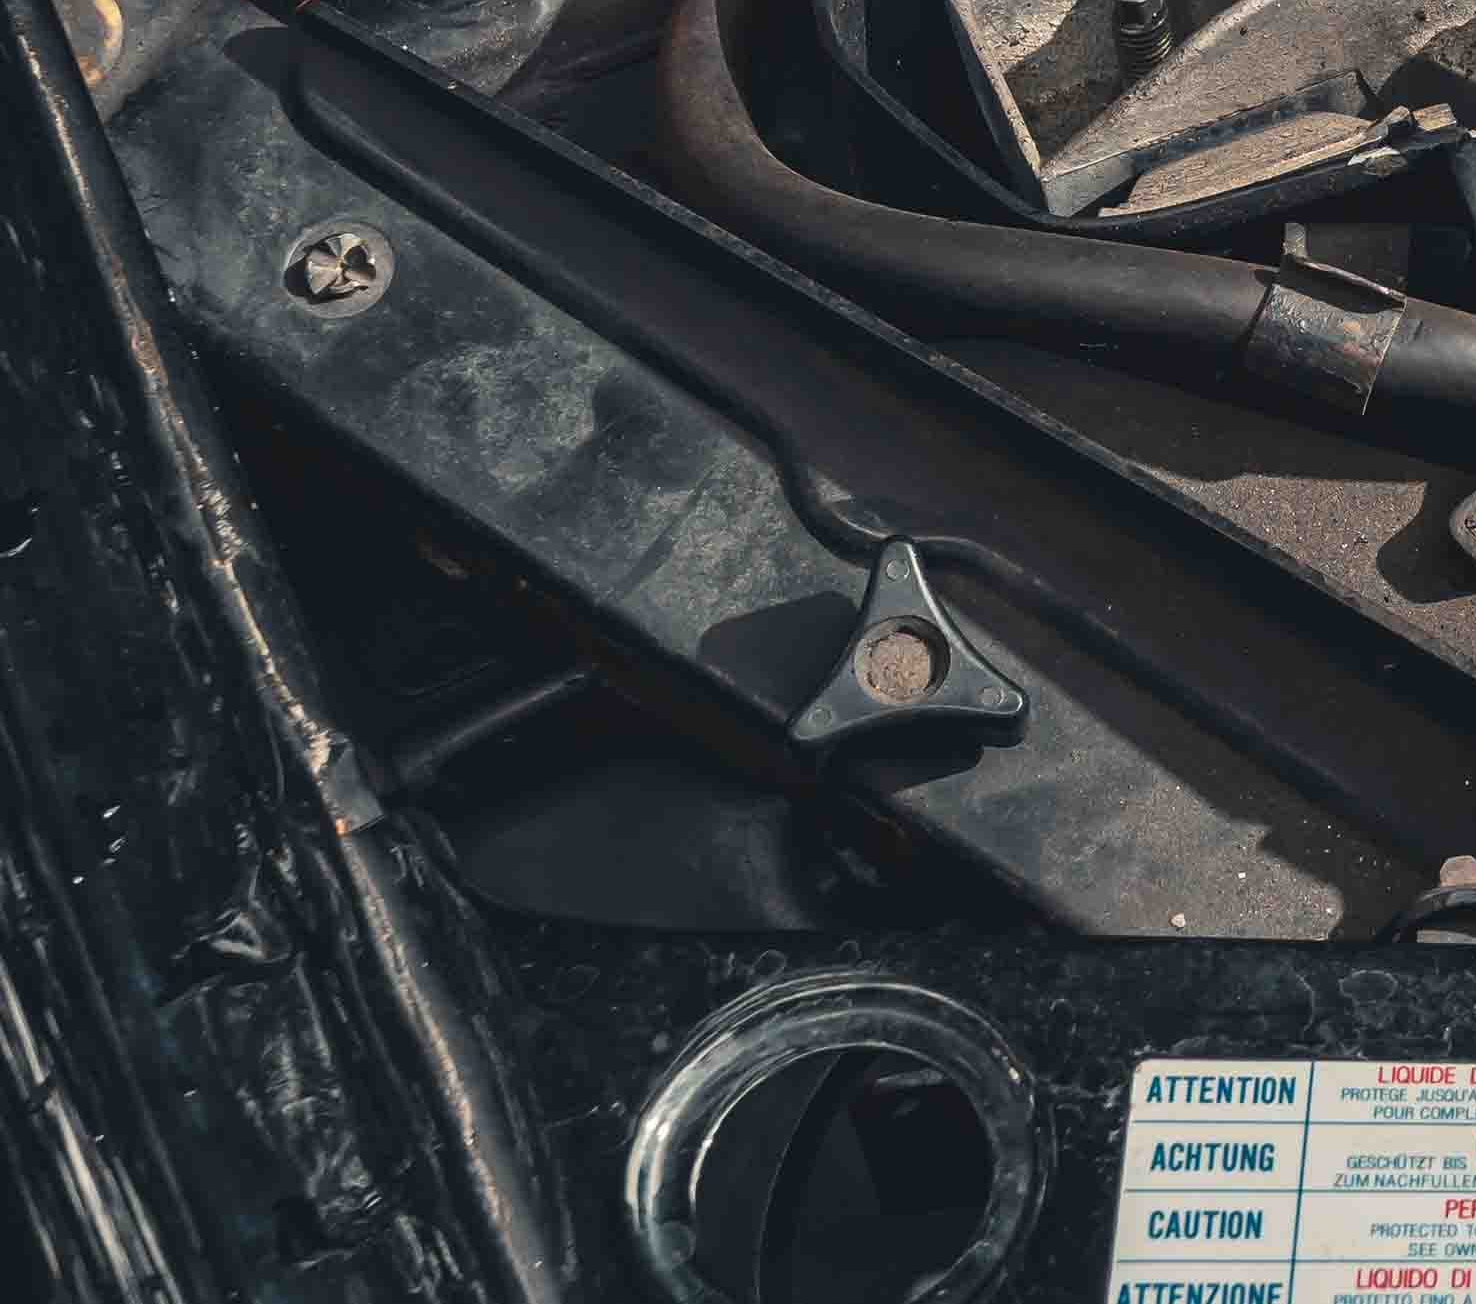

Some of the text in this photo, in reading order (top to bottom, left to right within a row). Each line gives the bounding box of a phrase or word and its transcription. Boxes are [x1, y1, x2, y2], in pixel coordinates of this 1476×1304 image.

[1378, 1066, 1456, 1084] LIQUIDE
[1146, 1076, 1296, 1104] ATTENTION
[1341, 1088, 1408, 1102] PROTEGE
[1374, 1107, 1415, 1119] POUR
[1150, 1143, 1275, 1173] ACHTUNG
[1347, 1154, 1433, 1168] GESCHÜTZT
[1443, 1156, 1467, 1168] BIS
[1334, 1173, 1374, 1188] ZUM
[1148, 1210, 1263, 1239] CAUTION
[1370, 1224, 1457, 1238] PROTECTED
[1408, 1244, 1438, 1257] SEE
[1356, 1269, 1438, 1288] LIQUIDO
[1452, 1269, 1471, 1288] DI
[1115, 1282, 1282, 1304] ATTENZIONE
